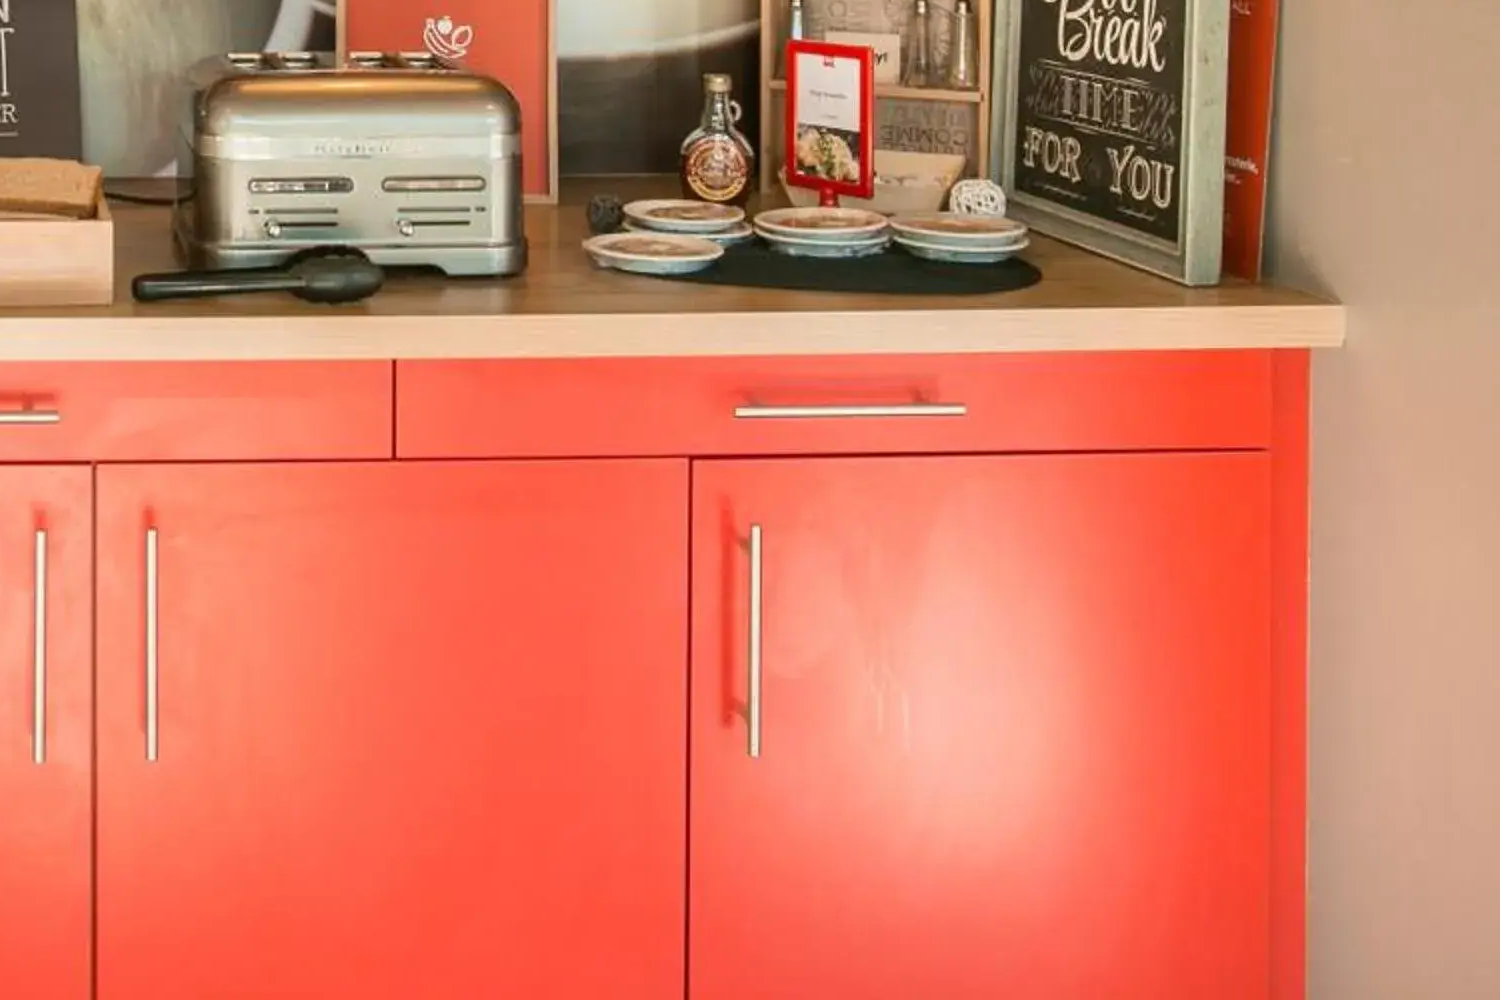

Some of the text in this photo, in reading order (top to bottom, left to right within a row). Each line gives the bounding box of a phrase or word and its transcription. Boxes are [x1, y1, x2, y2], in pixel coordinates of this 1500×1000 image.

[1060, 75, 1139, 131] TIME
[1023, 125, 1175, 209] FOR YOU
